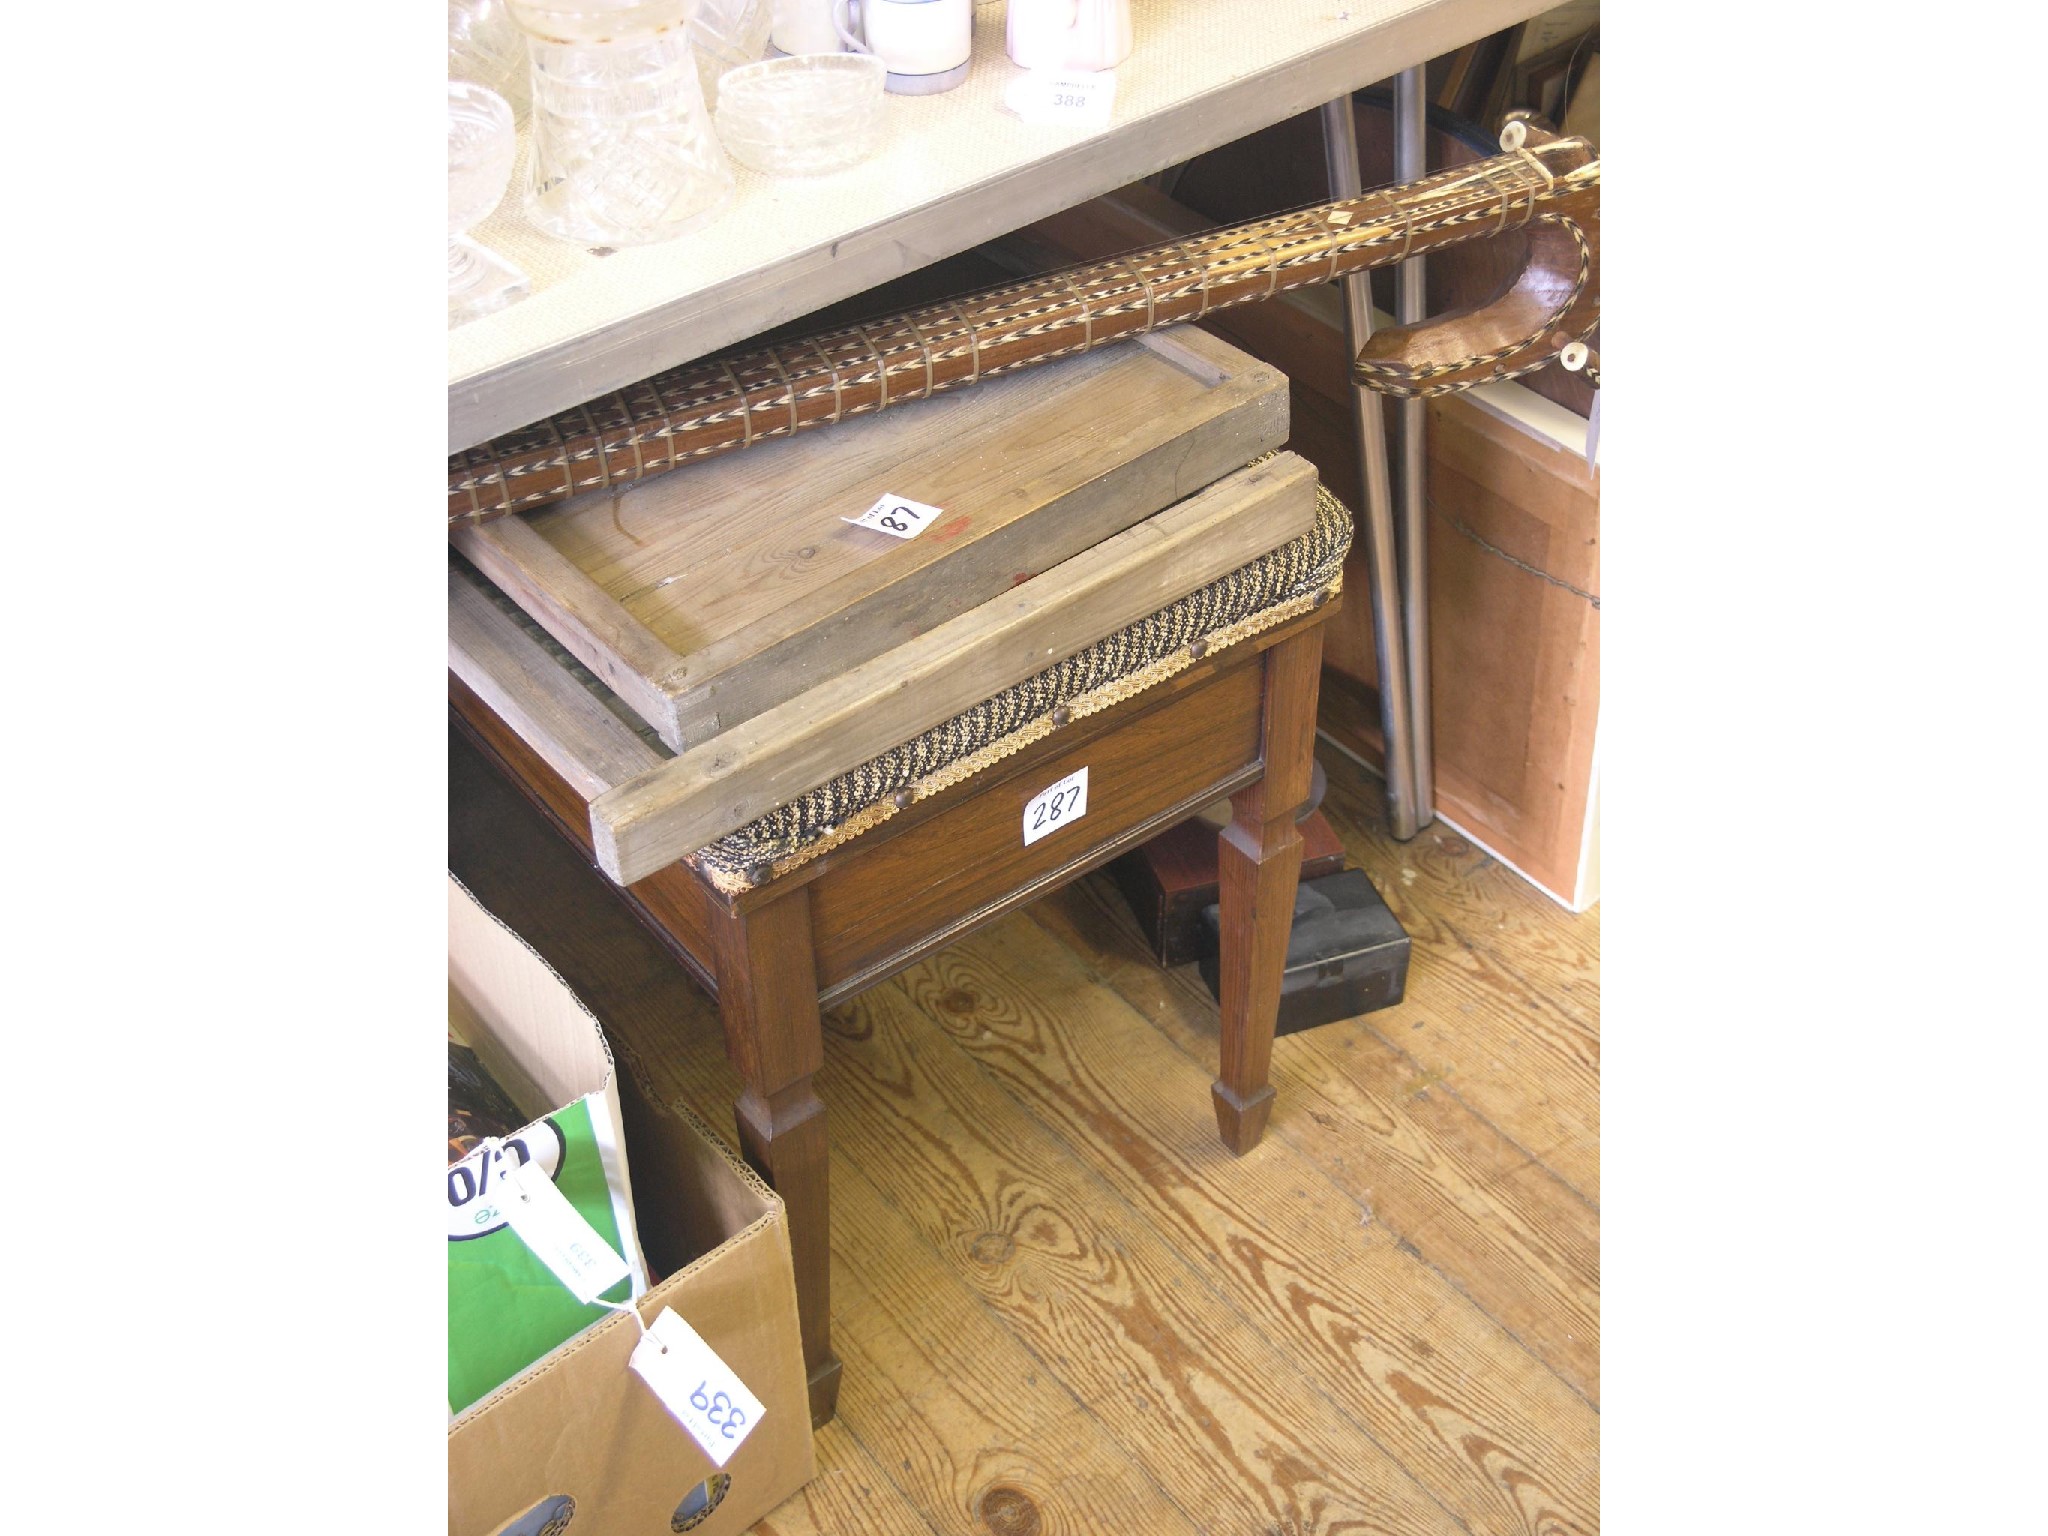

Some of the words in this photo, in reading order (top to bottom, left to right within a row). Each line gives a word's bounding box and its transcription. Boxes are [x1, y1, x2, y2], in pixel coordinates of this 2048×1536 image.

[1053, 93, 1087, 109] 388
[880, 506, 921, 532] 87
[1032, 785, 1081, 831] 287
[689, 1379, 747, 1440] 339
